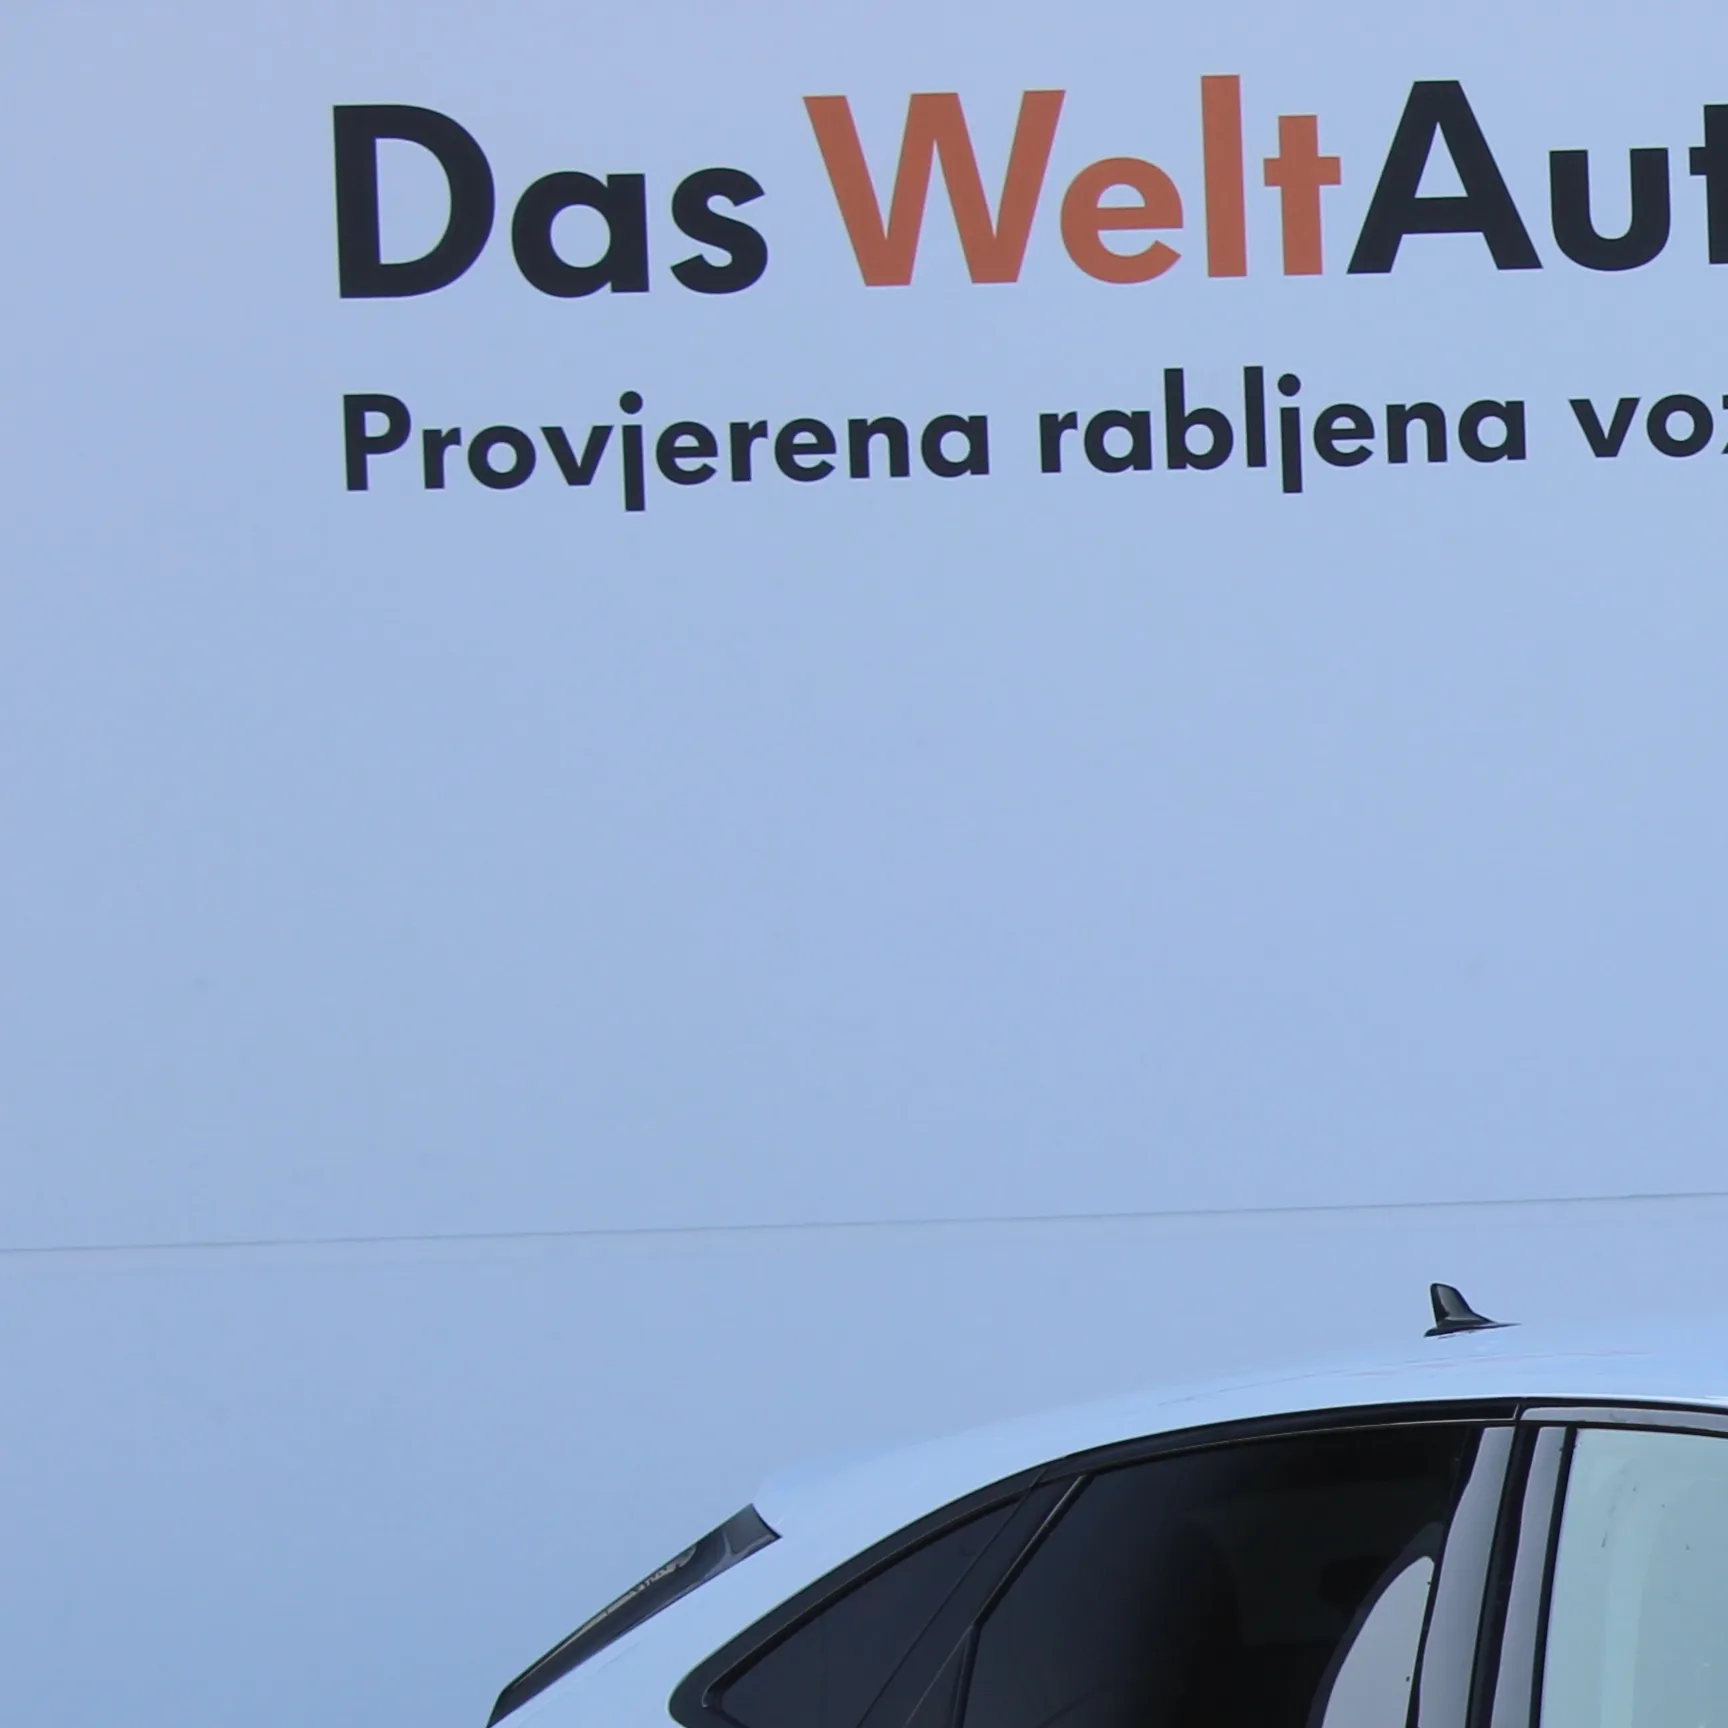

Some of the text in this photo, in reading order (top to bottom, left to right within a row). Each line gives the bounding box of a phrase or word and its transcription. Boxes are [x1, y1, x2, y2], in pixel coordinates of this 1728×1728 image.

[332, 104, 768, 299] Das
[342, 390, 989, 512] Provjerena
[1039, 365, 1526, 494] rabljena
